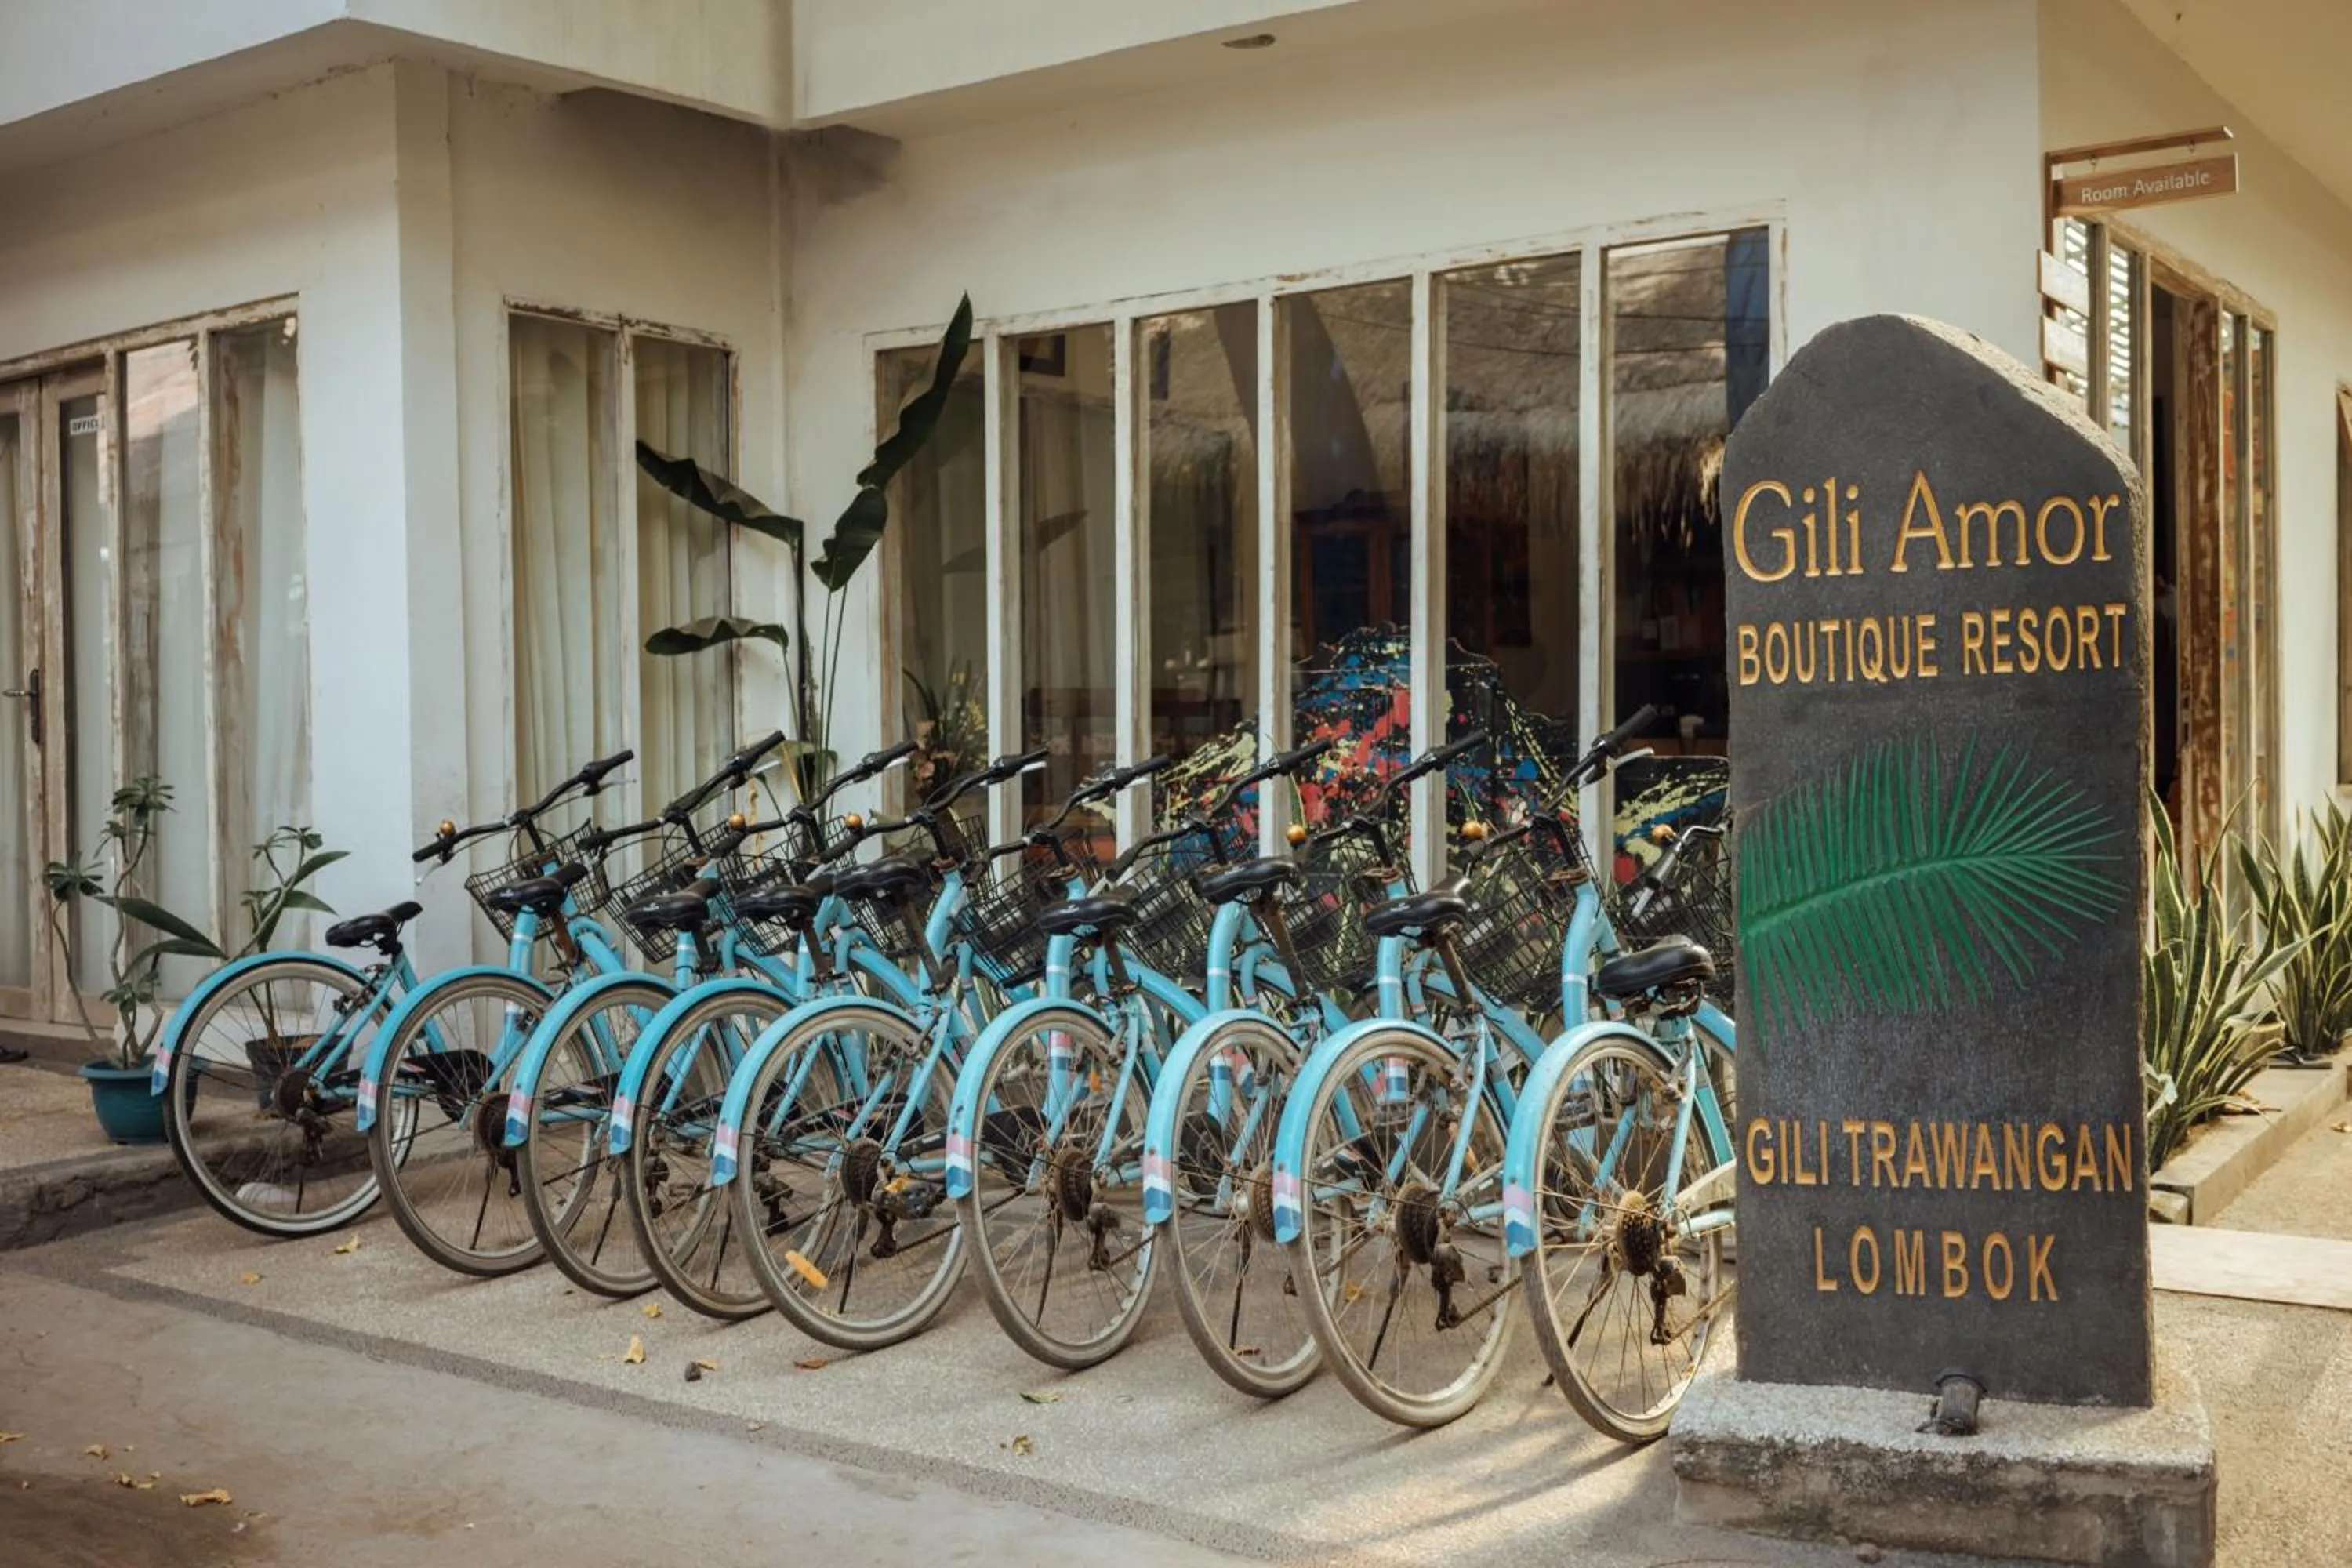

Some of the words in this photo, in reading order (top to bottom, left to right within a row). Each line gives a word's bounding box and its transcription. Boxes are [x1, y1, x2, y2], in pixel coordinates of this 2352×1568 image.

[2082, 186, 2127, 203] Room
[2133, 169, 2211, 195] Available
[1733, 476, 1864, 583] Gili
[1890, 470, 2121, 572] Amor
[1737, 614, 1939, 686] BOUTIQUE
[1962, 603, 2127, 676] RESORT
[1745, 1116, 1830, 1186] GILI
[1842, 1119, 2133, 1192] TRAWANGAN
[1813, 1225, 2060, 1301] LOMBOK
